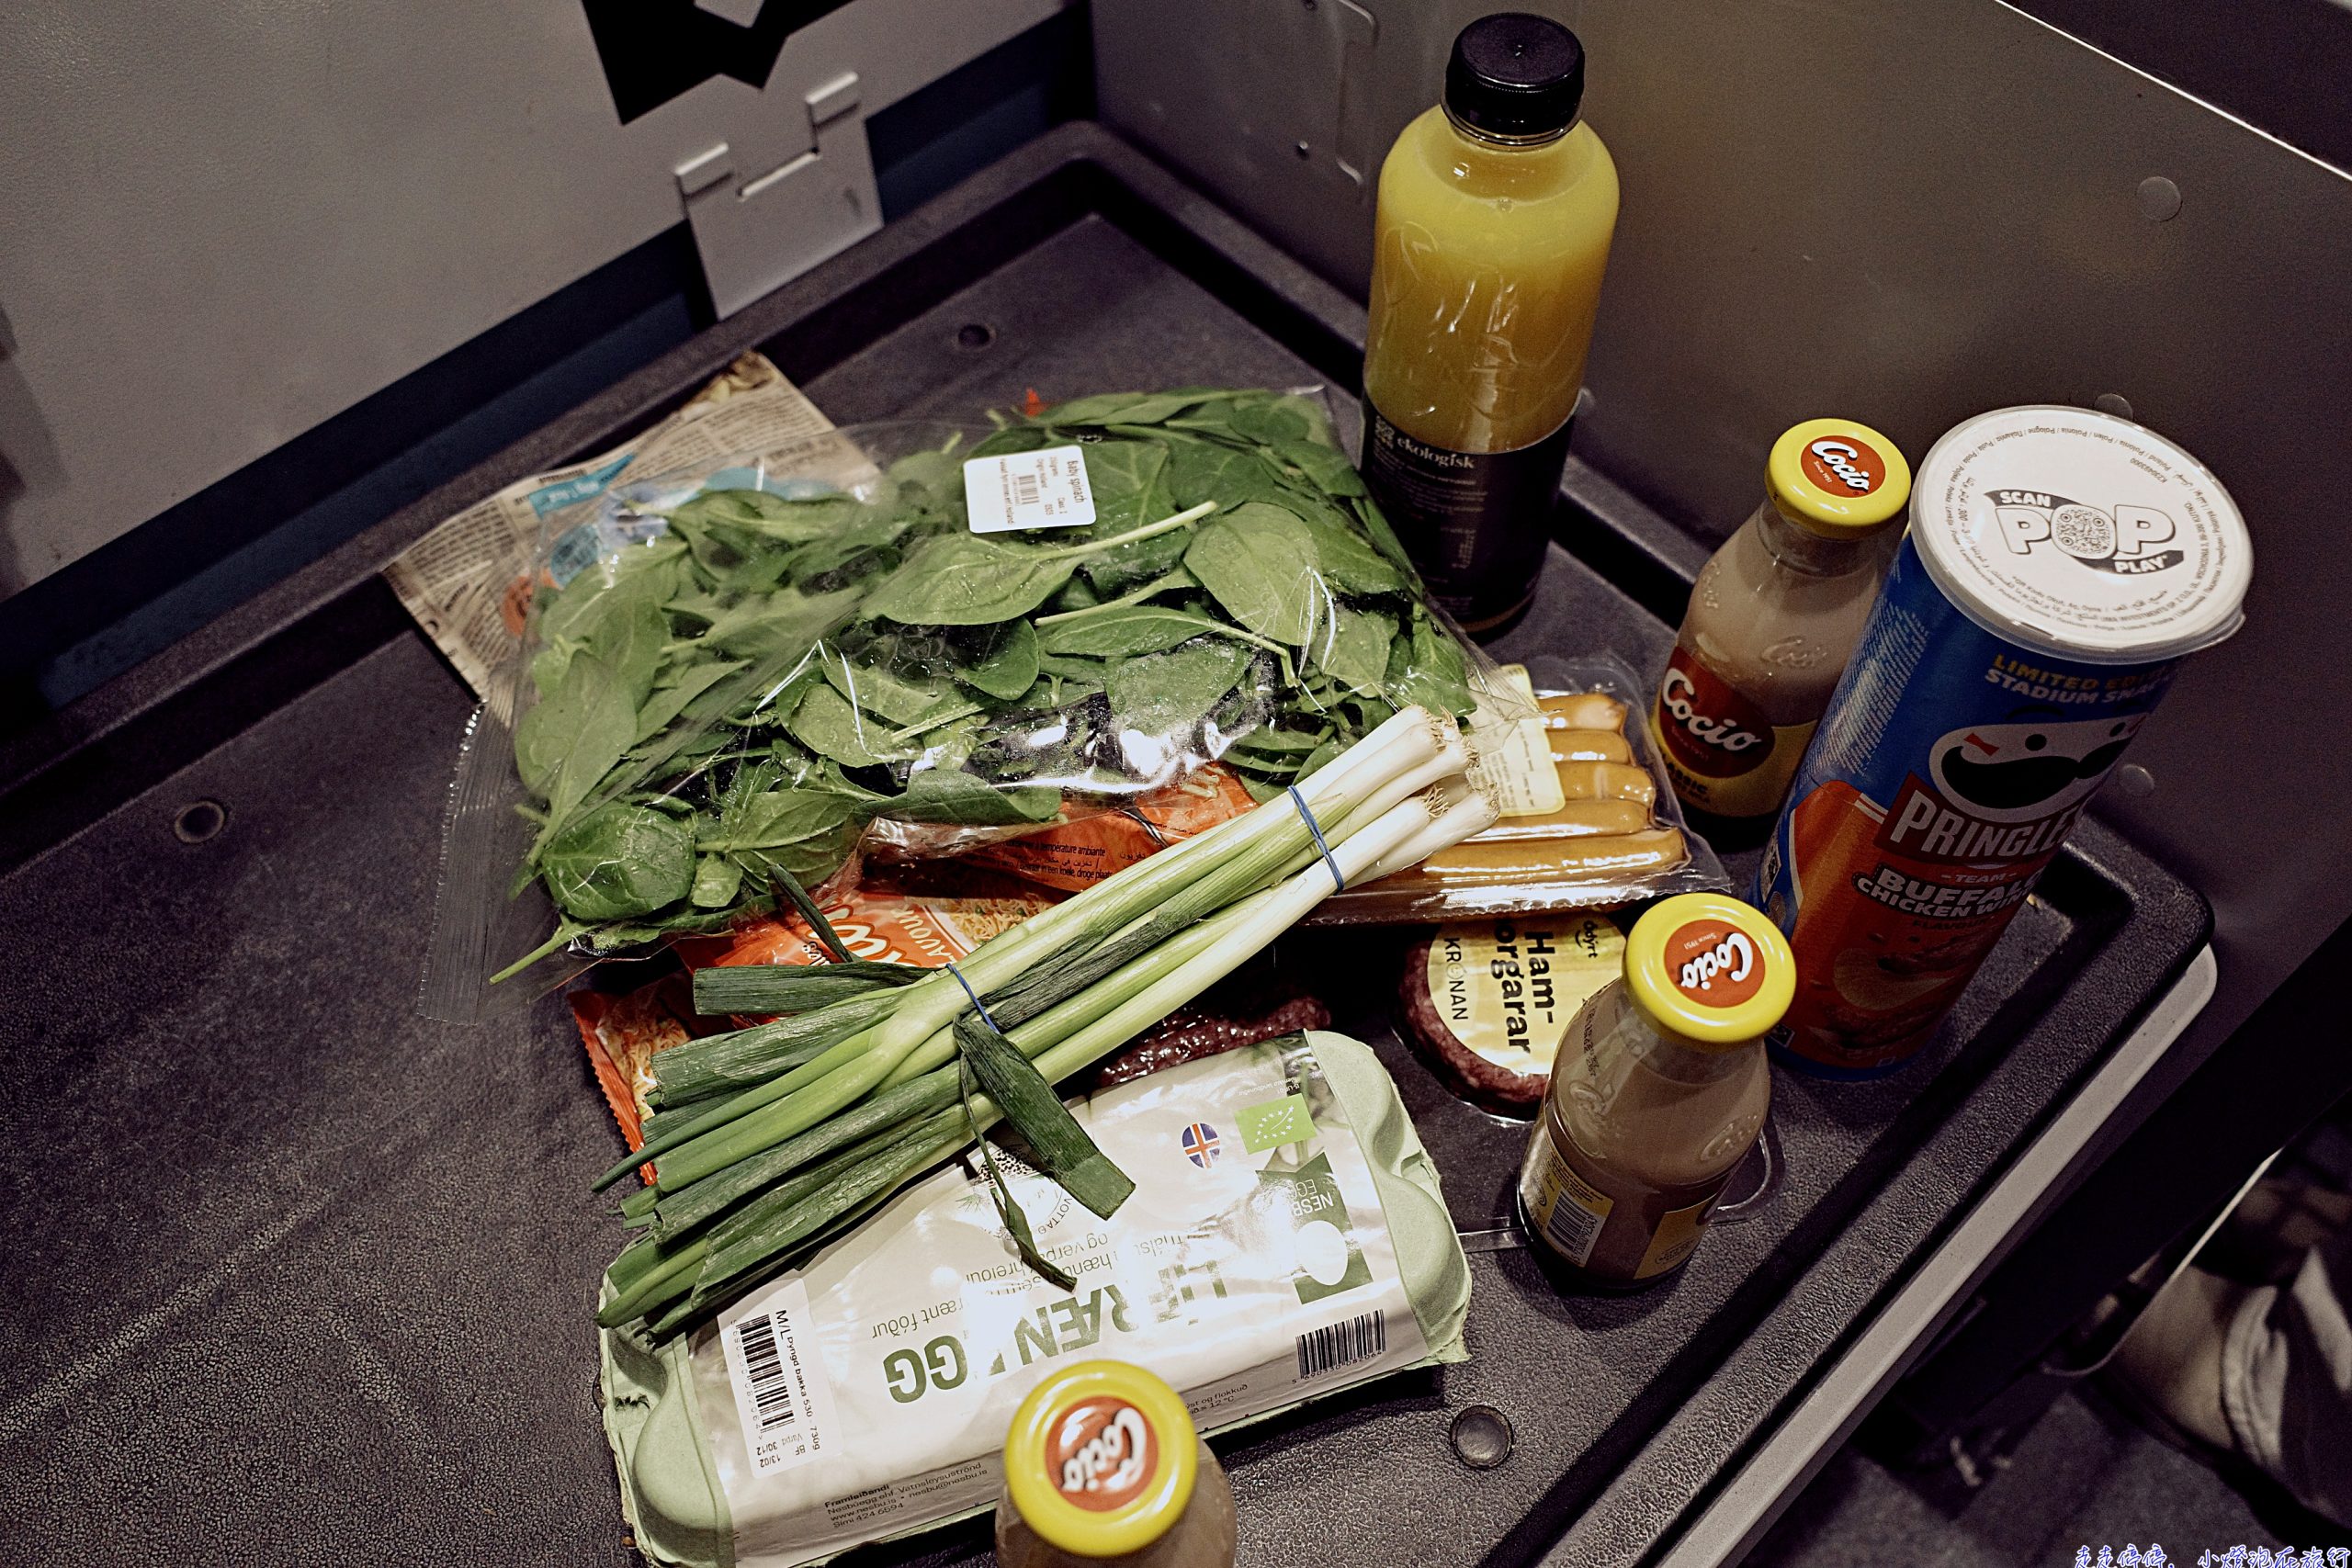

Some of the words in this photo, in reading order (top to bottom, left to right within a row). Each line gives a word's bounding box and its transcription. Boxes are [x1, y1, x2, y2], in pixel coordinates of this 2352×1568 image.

[2025, 424, 2055, 436] Pologne
[2093, 432, 2113, 443] Polen
[1065, 459, 1080, 477] Baby
[1811, 441, 1871, 491] Cocio
[2146, 454, 2172, 471] Poland
[1068, 477, 1087, 503] spinach
[1999, 491, 2052, 508] SCAN
[1993, 653, 2099, 691] LIMITED
[1984, 668, 2099, 705] STADIUM
[1663, 667, 1762, 751] Cocio
[1077, 844, 1106, 858] ambiante
[1076, 865, 1094, 880] droge
[1954, 872, 2007, 884] TEAM
[1857, 876, 1973, 918] CHICKEN
[1679, 931, 1755, 991] Cocio
[1524, 930, 1555, 1024] Ham-
[1289, 1190, 1334, 1216] NESB
[1085, 1229, 1109, 1252] og
[1060, 1254, 1113, 1280] hænu
[774, 1308, 793, 1340] M/L
[872, 1314, 921, 1339] fóður
[784, 1336, 800, 1367] Þyngd
[792, 1367, 808, 1398] bakka
[1200, 1394, 1213, 1404] og
[1213, 1382, 1249, 1399] flokkuð
[801, 1398, 814, 1418] 530
[1208, 1399, 1222, 1407] 12
[754, 1441, 779, 1456] 30/12
[792, 1443, 807, 1456] BF
[807, 1424, 822, 1451] 730g
[1061, 1406, 1148, 1493] Cocio
[758, 1454, 782, 1469] 13/02
[823, 1483, 890, 1508] Framleiðandi
[826, 1494, 878, 1517] Nesbúegg
[896, 1461, 983, 1494] Vatnsleysuströnd
[829, 1496, 898, 1522] www.nesbu.is
[907, 1467, 989, 1498] nesbu@nesbu.is
[854, 1509, 876, 1522] 424
[876, 1501, 904, 1516] 6594
